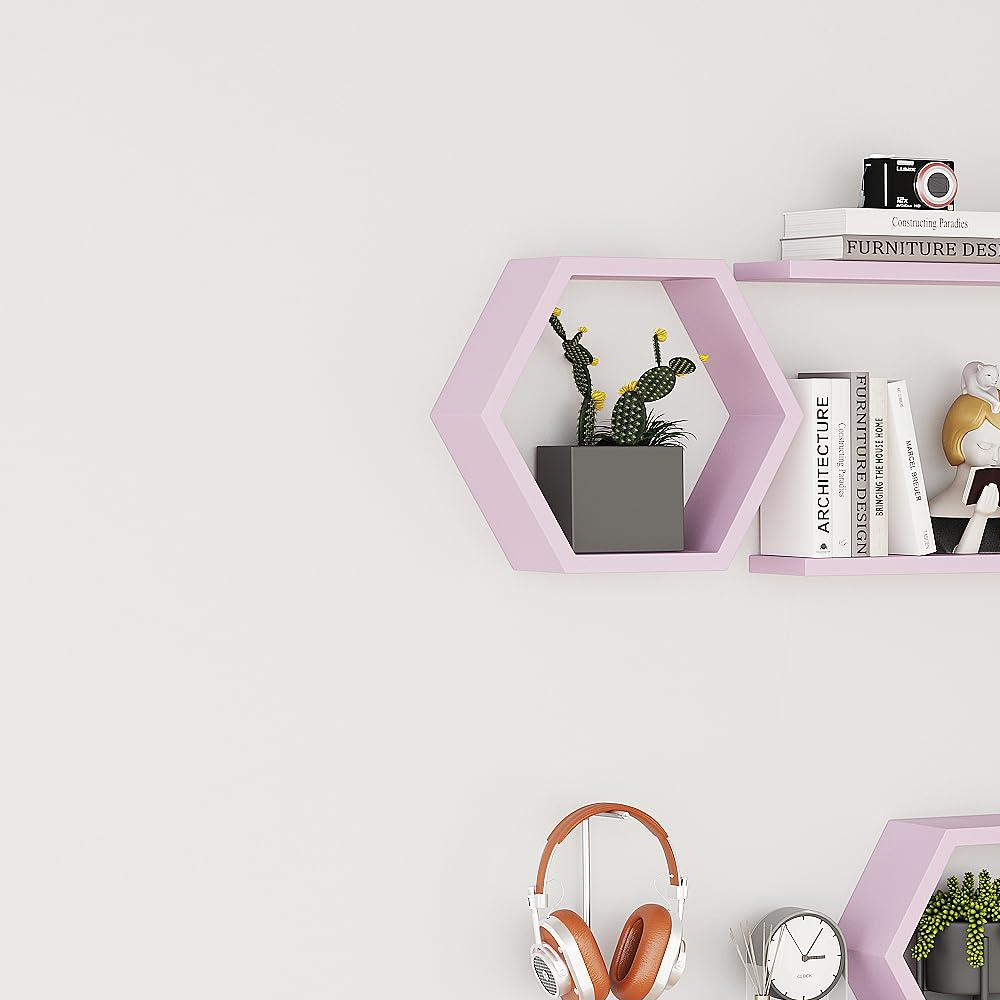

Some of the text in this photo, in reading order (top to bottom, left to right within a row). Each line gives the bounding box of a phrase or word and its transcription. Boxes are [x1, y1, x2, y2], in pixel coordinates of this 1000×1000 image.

[847, 240, 957, 256] FURNITURE
[892, 217, 937, 230] Constructing
[817, 396, 830, 533] ARCHITECTURE
[836, 422, 847, 467] Constructing
[856, 375, 867, 555] FURNITURE DESIGN
[875, 417, 884, 517] BRINGING THE HOUSE HOME
[905, 440, 922, 502] MARCEL BREUER
